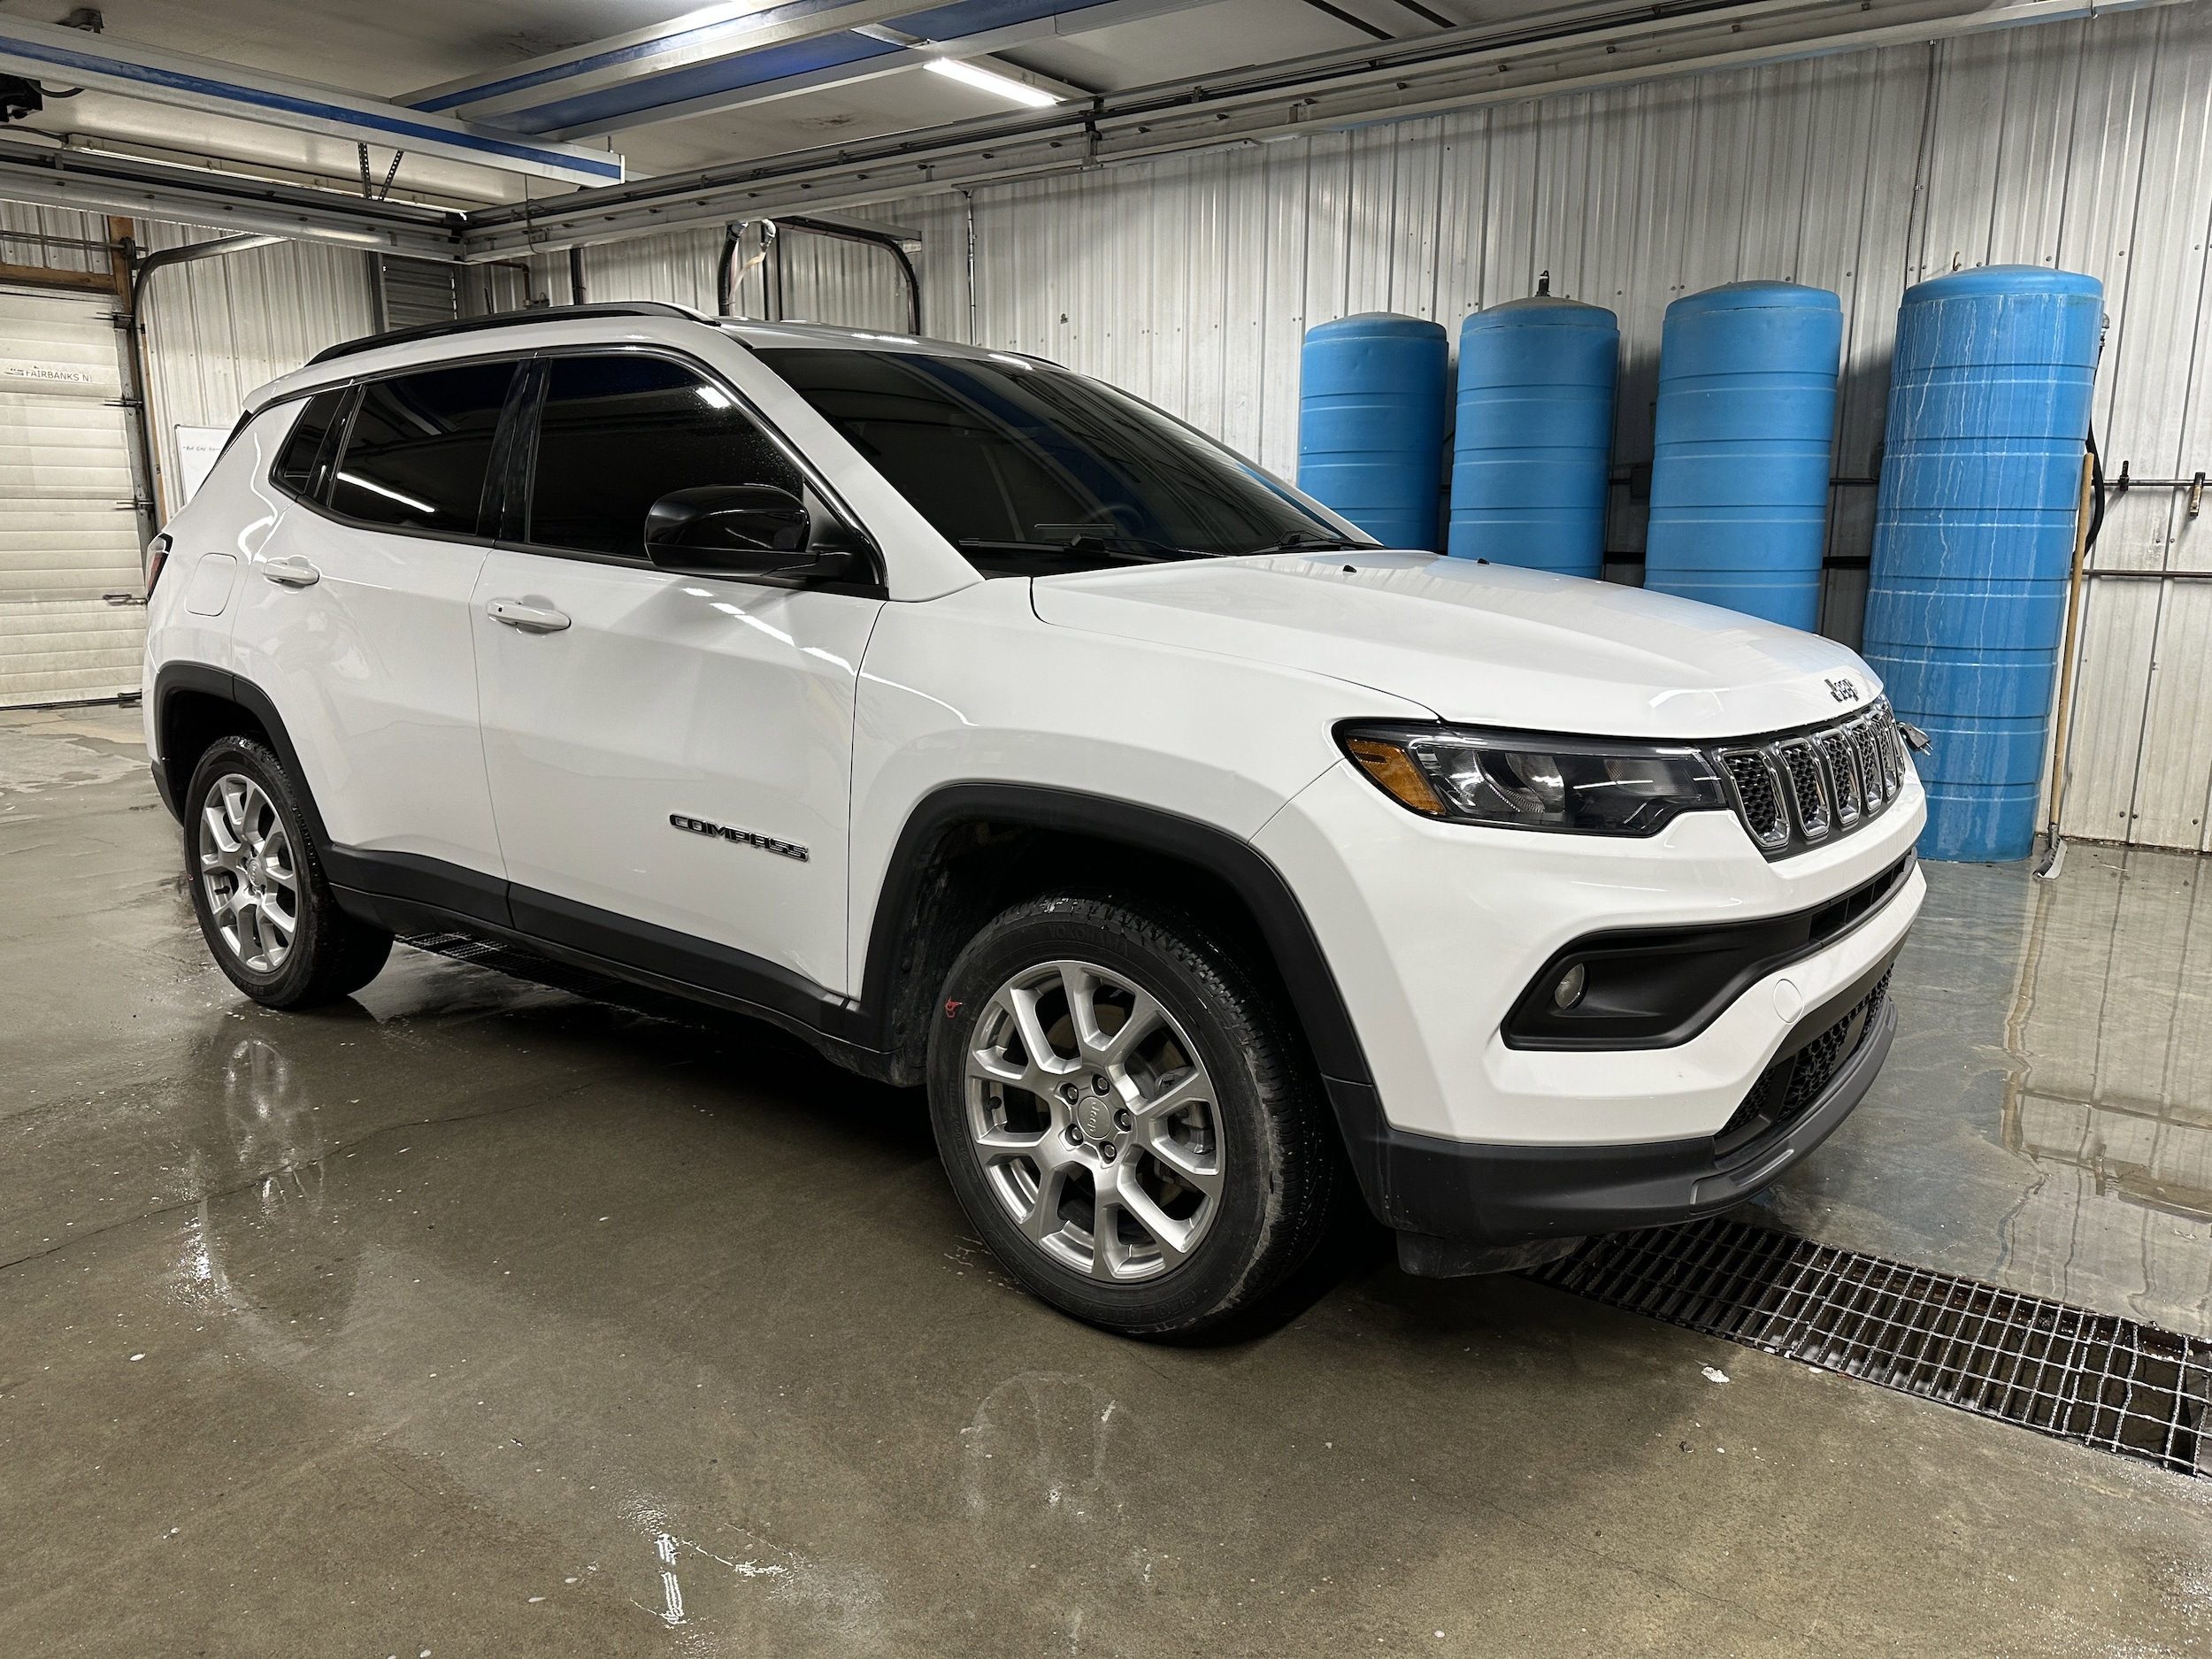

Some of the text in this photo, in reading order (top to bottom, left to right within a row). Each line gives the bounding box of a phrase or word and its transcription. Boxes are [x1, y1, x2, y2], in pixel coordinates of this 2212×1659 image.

[26, 369, 80, 381] FAIRBANKS
[1824, 679, 1859, 703] Jeep
[669, 813, 809, 862] COMPASS
[1048, 924, 1128, 956] YOKOHAMA
[1087, 1102, 1100, 1133] Jeep
